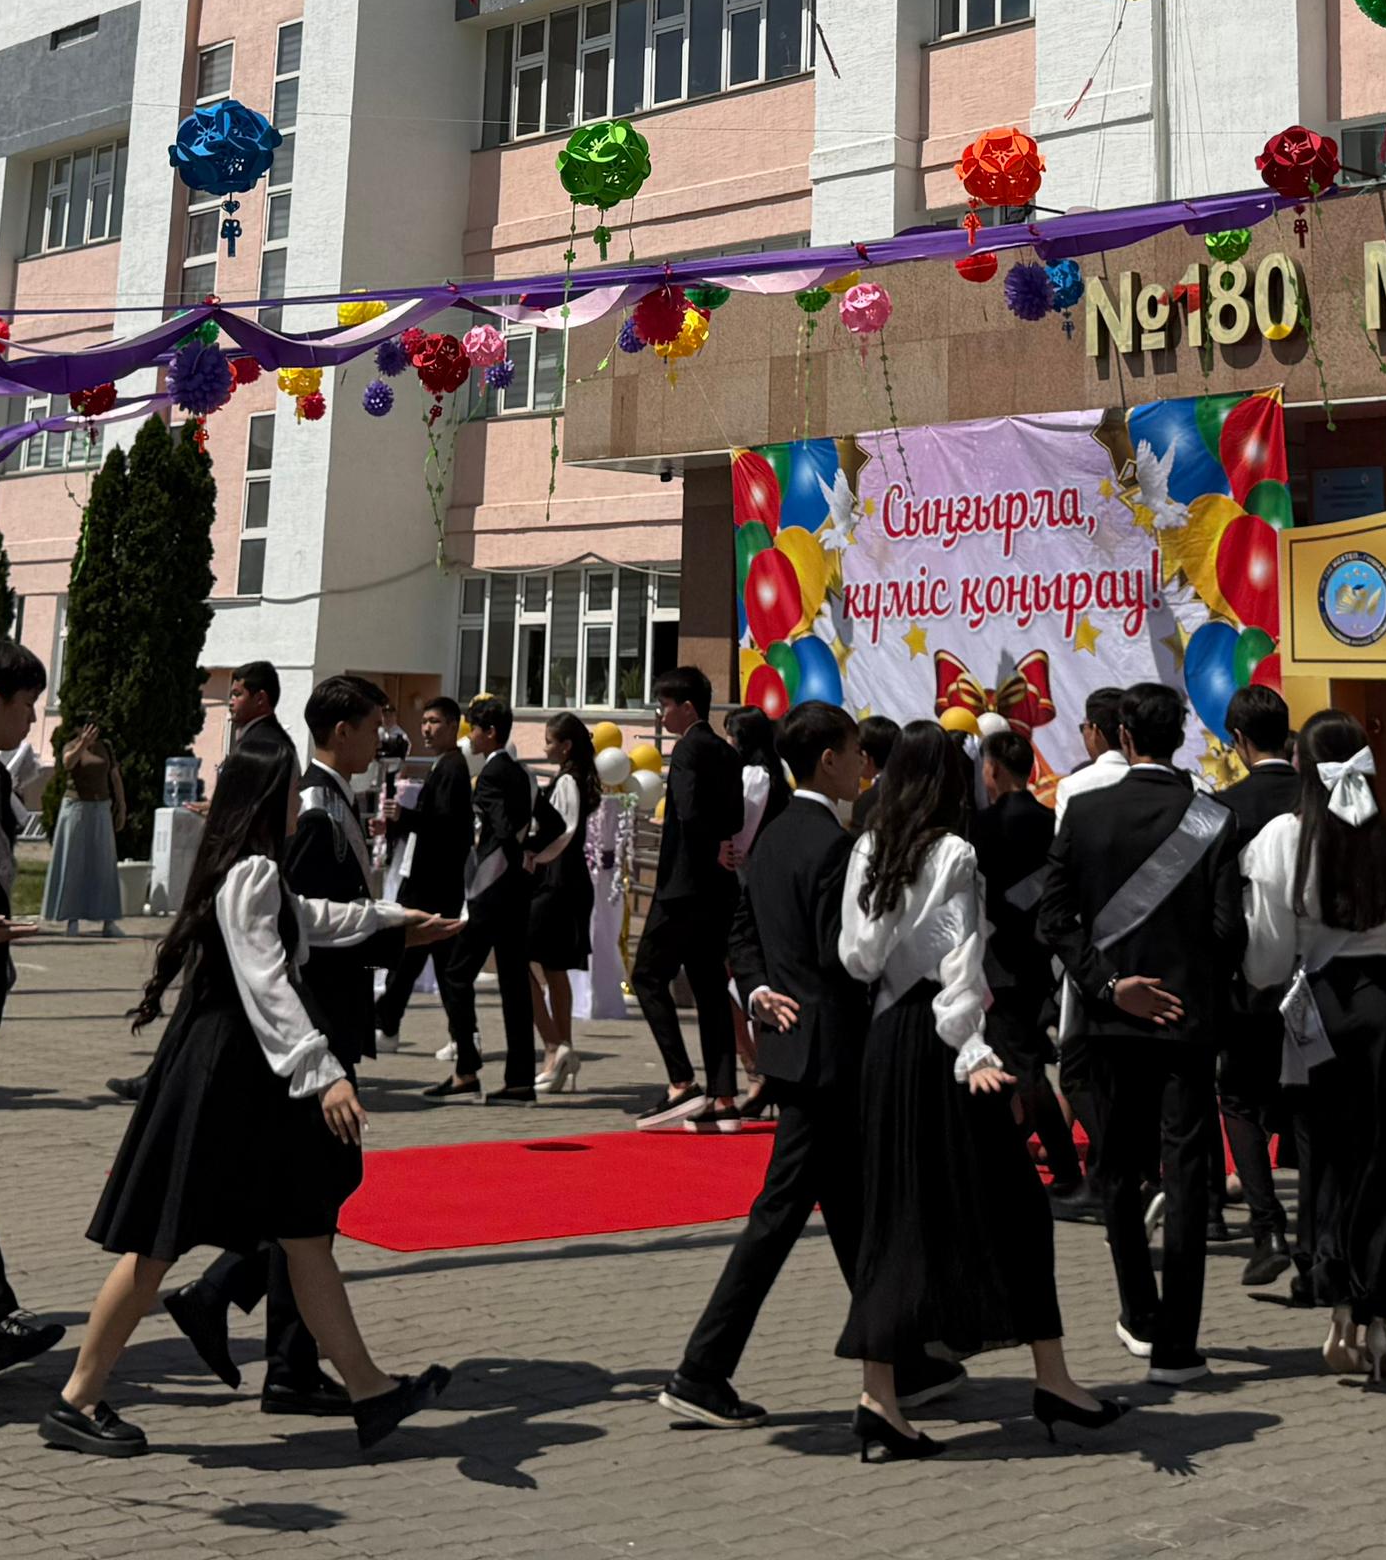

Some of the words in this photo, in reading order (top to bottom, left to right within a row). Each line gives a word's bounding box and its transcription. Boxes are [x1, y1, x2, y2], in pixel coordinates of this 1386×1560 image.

[1086, 252, 1305, 357] №180
[882, 483, 1096, 557] Сыңғырла,
[842, 565, 952, 644] күміс
[960, 549, 1161, 639] қоңырау!
